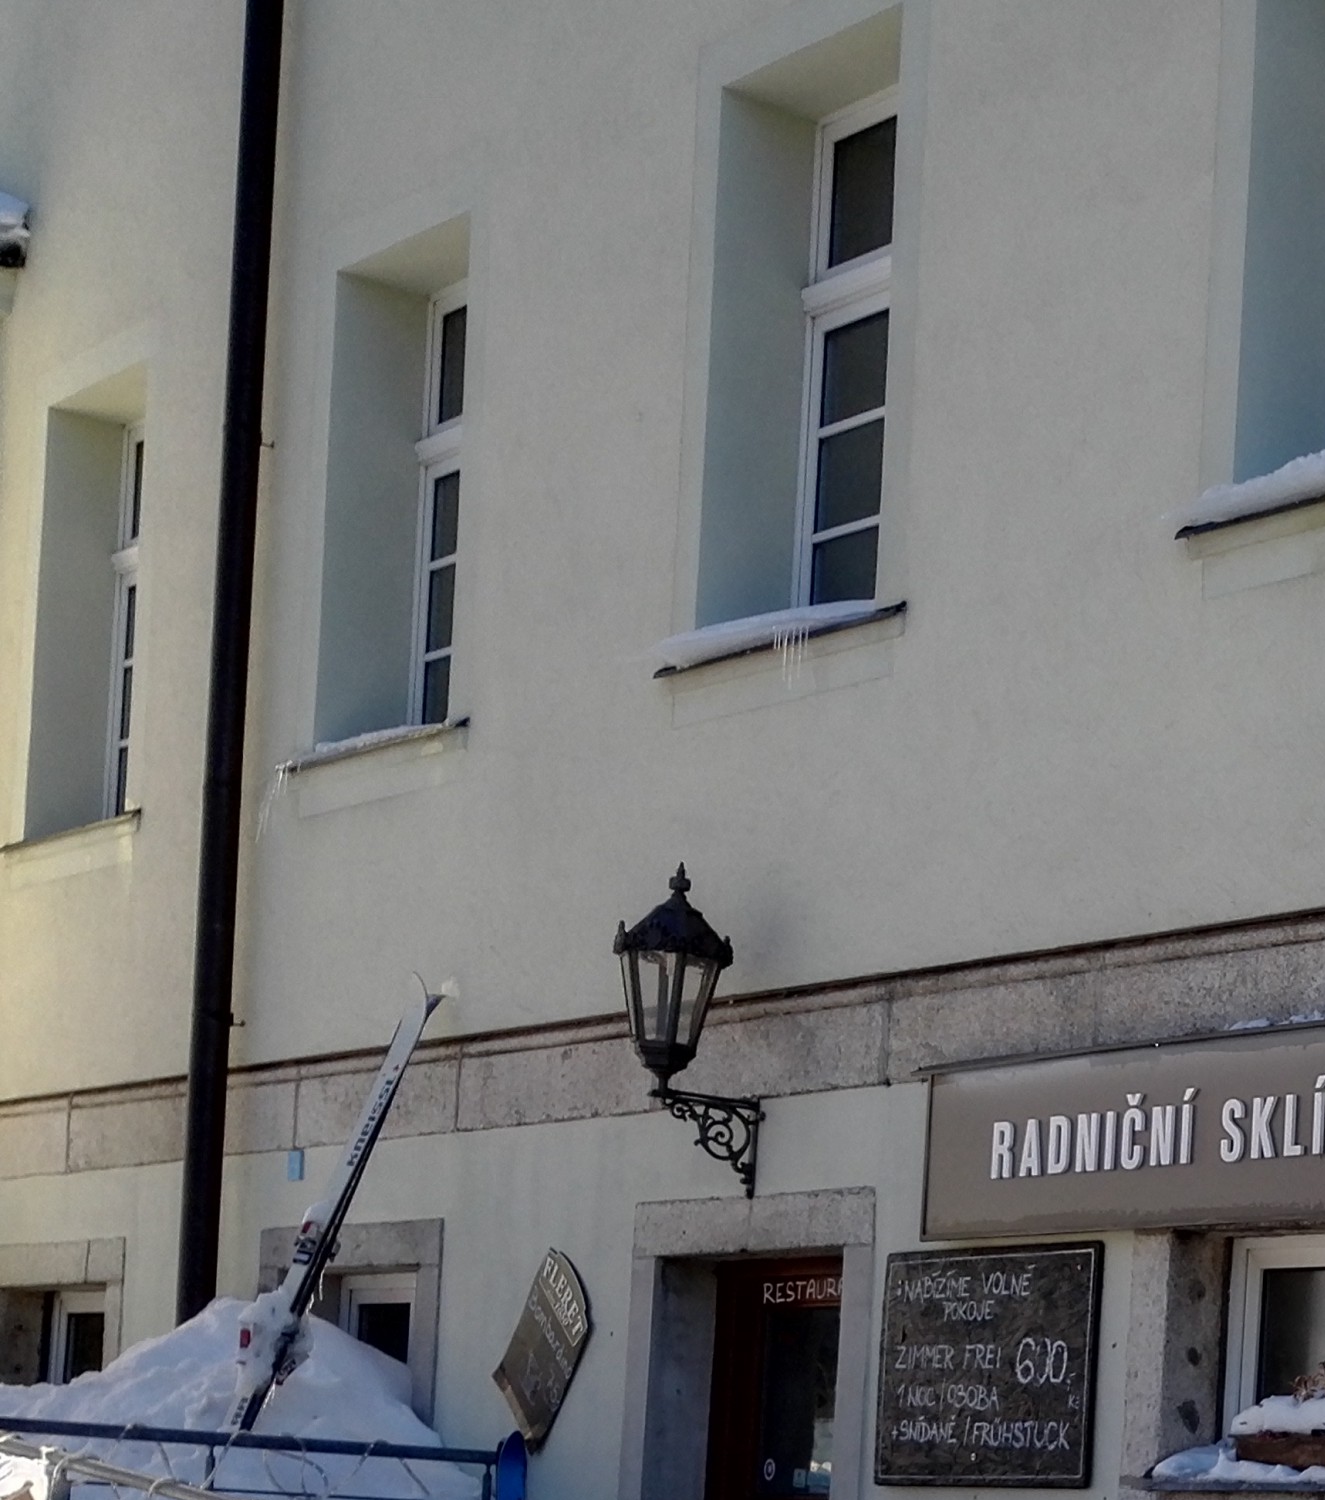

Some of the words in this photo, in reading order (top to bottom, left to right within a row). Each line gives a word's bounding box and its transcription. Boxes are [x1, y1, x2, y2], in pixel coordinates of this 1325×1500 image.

[990, 1087, 1198, 1180] RADNIČNÍ
[542, 1256, 584, 1336] FLERET
[981, 1264, 1037, 1296] VOLNÉ
[942, 1300, 995, 1321] POKOJE
[895, 1344, 954, 1370] ZIMMER
[962, 1344, 1001, 1370] FREI
